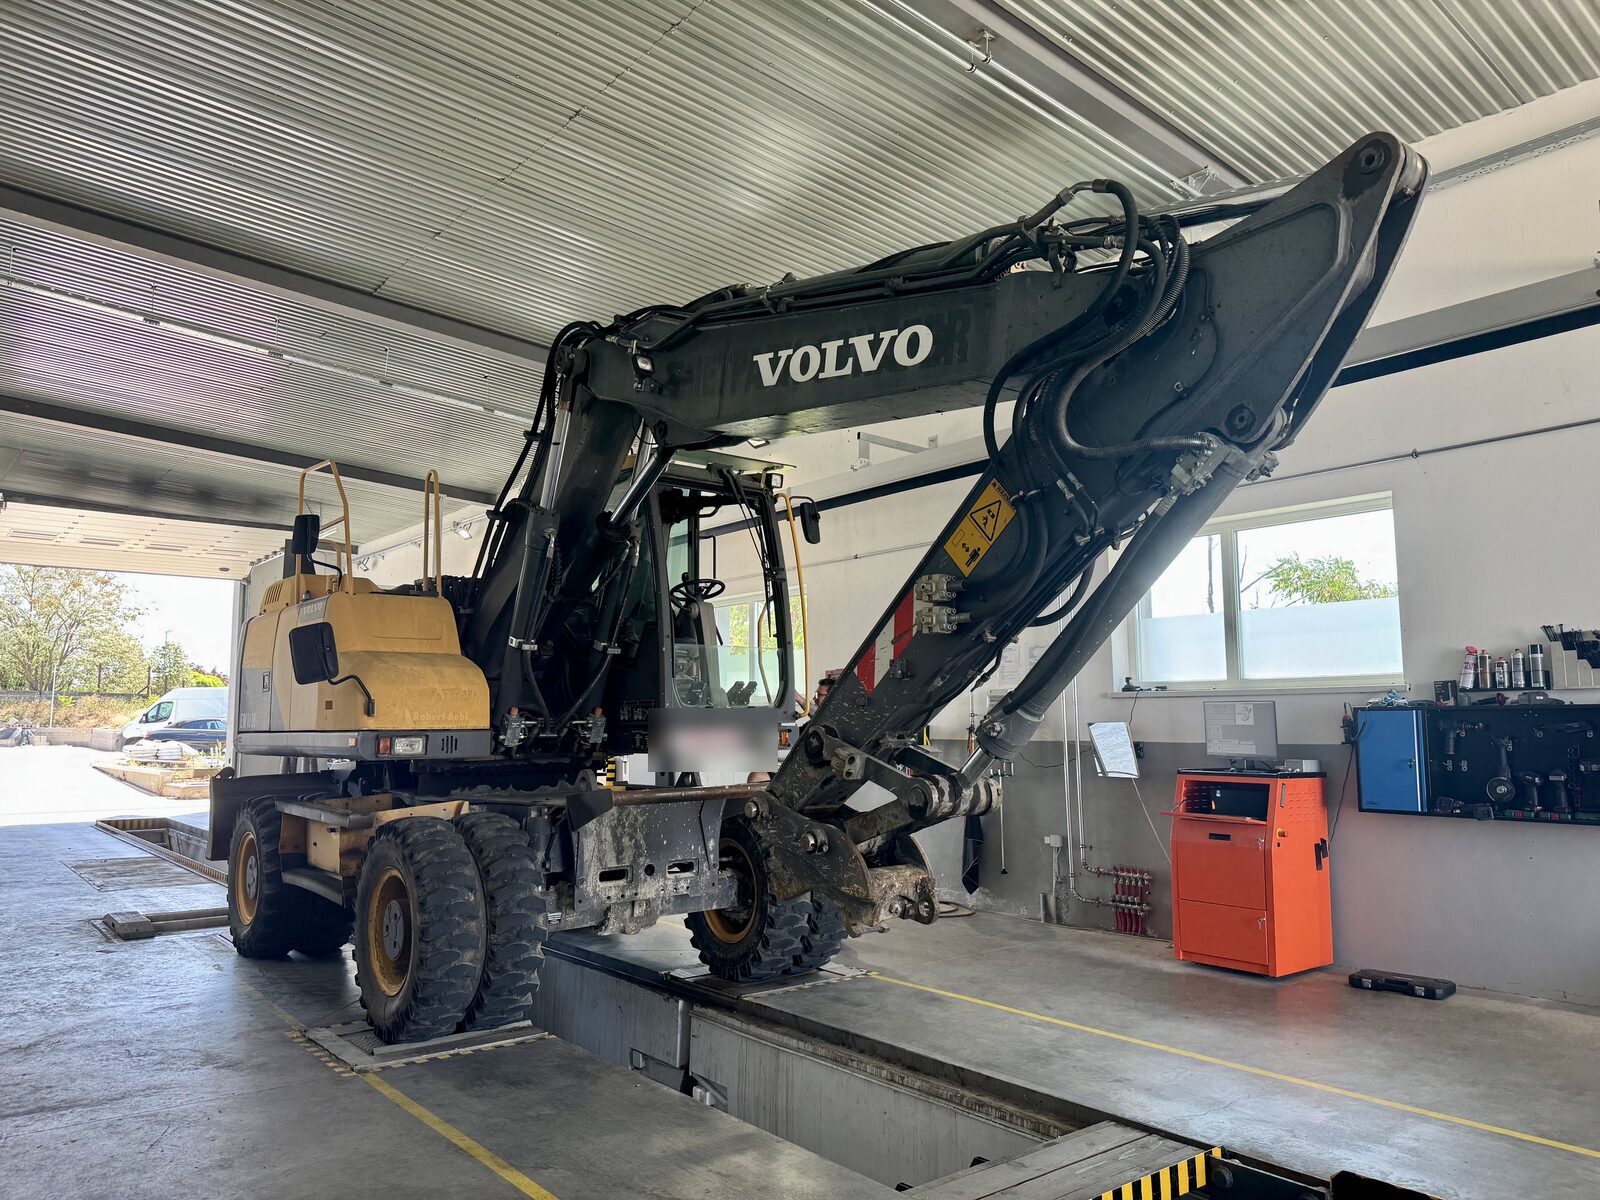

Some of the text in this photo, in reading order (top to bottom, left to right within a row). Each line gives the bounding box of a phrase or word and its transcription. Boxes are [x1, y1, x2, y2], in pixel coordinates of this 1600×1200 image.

[753, 324, 933, 387] VOLVO
[413, 711, 469, 721] Robert Aebi
